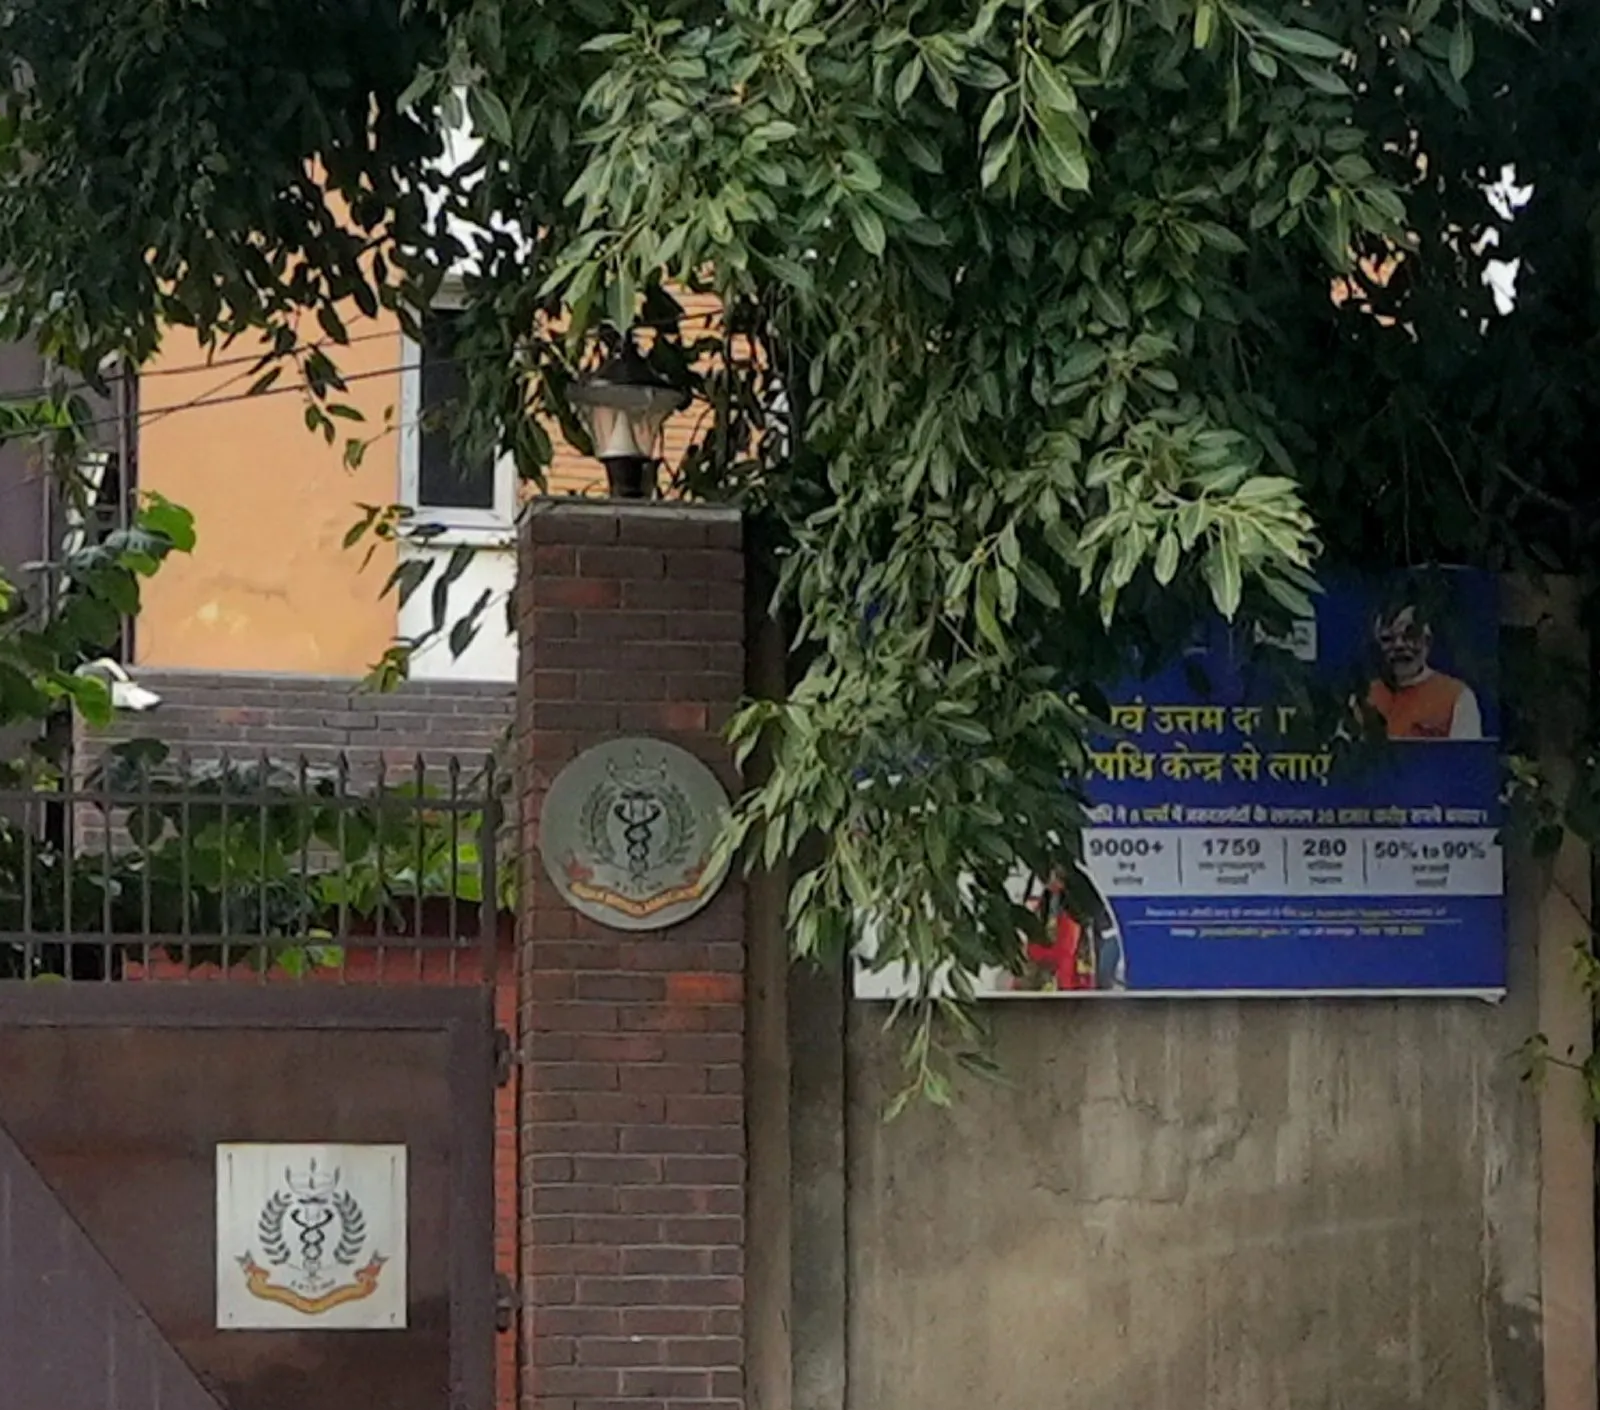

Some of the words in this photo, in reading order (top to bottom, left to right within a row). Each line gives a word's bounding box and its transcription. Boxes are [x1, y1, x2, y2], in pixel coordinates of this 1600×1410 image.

[1153, 705, 1225, 735] उत्तम
[1161, 742, 1224, 782] केन्द्र
[1231, 743, 1261, 781] से
[1267, 744, 1333, 787] लाएं
[1089, 838, 1164, 857] 9000+
[1203, 838, 1261, 857] 1759
[1303, 838, 1347, 857] 280
[1374, 840, 1418, 859] 50%
[1422, 842, 1440, 859] to
[1442, 841, 1487, 860] 90%
